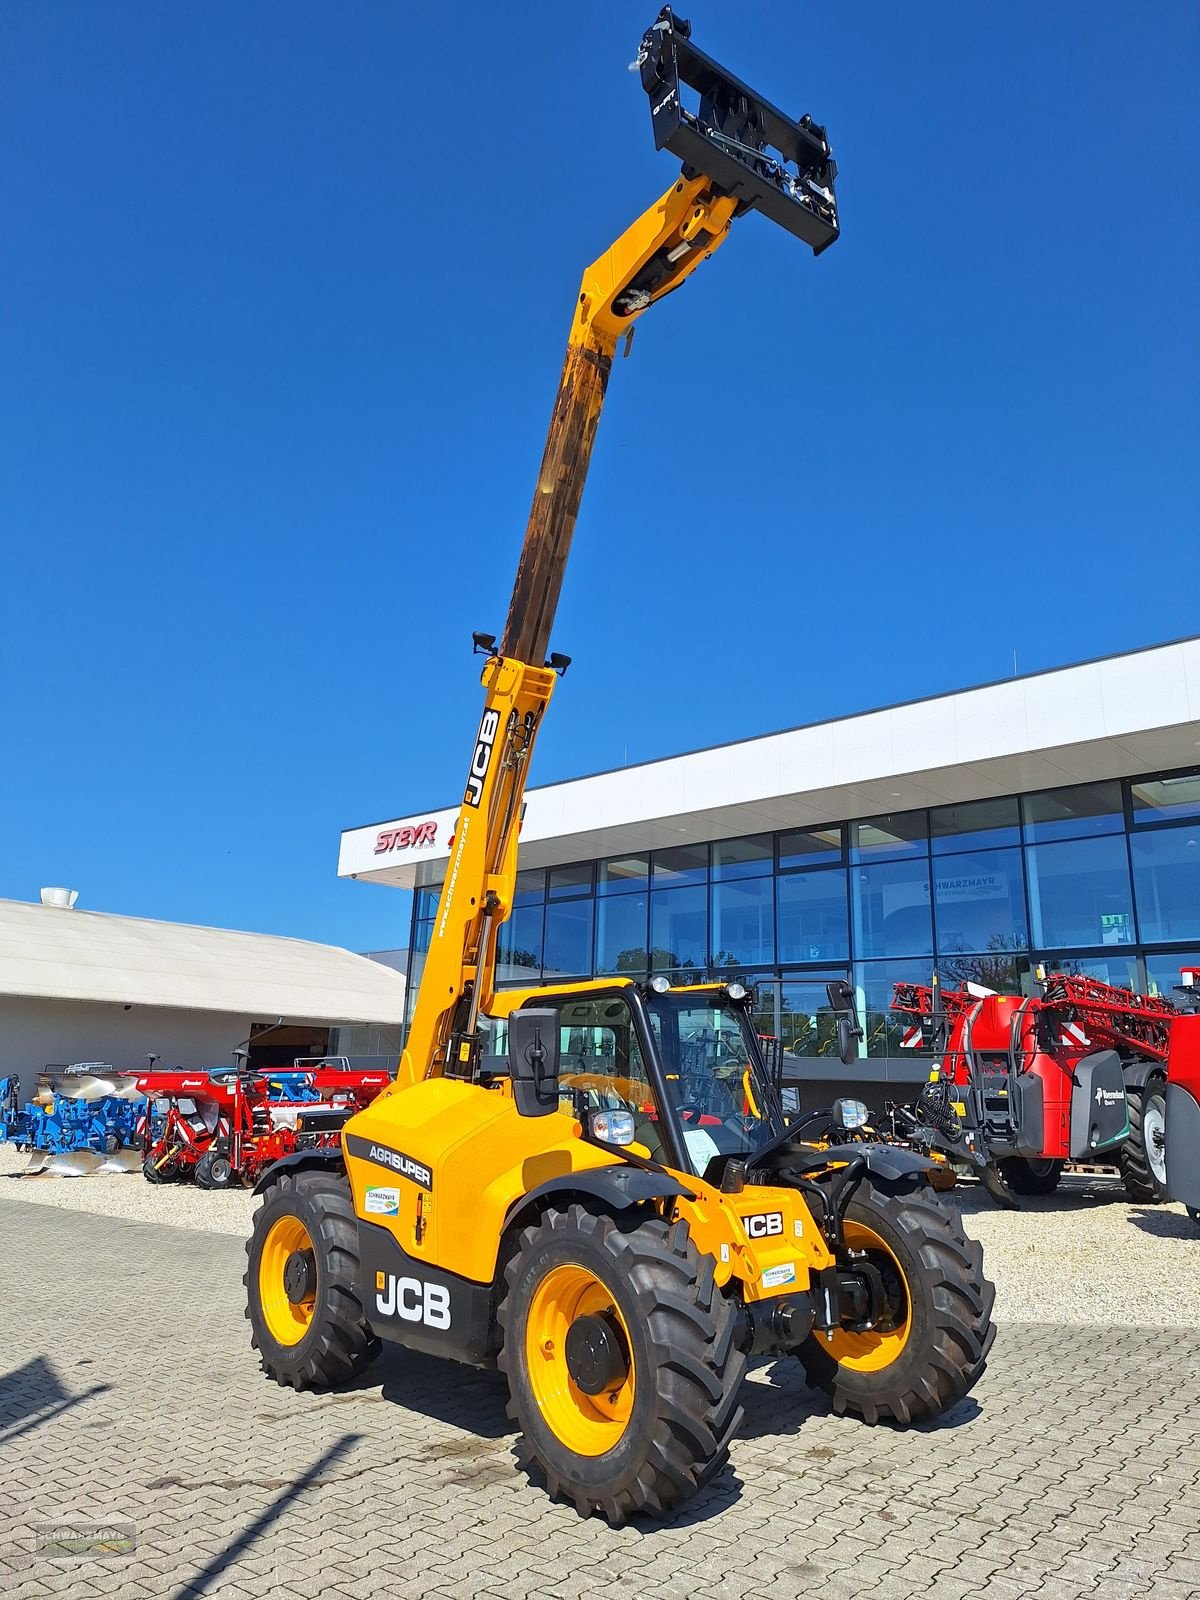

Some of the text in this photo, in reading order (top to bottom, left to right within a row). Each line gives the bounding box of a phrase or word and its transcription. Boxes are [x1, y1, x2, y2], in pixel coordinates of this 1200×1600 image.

[467, 711, 500, 806] JCB
[375, 822, 437, 854] STEYR
[438, 816, 470, 938] www.schwarzmayr.at
[923, 877, 995, 892] SHWARZMAYR
[376, 1274, 451, 1331] JCB
